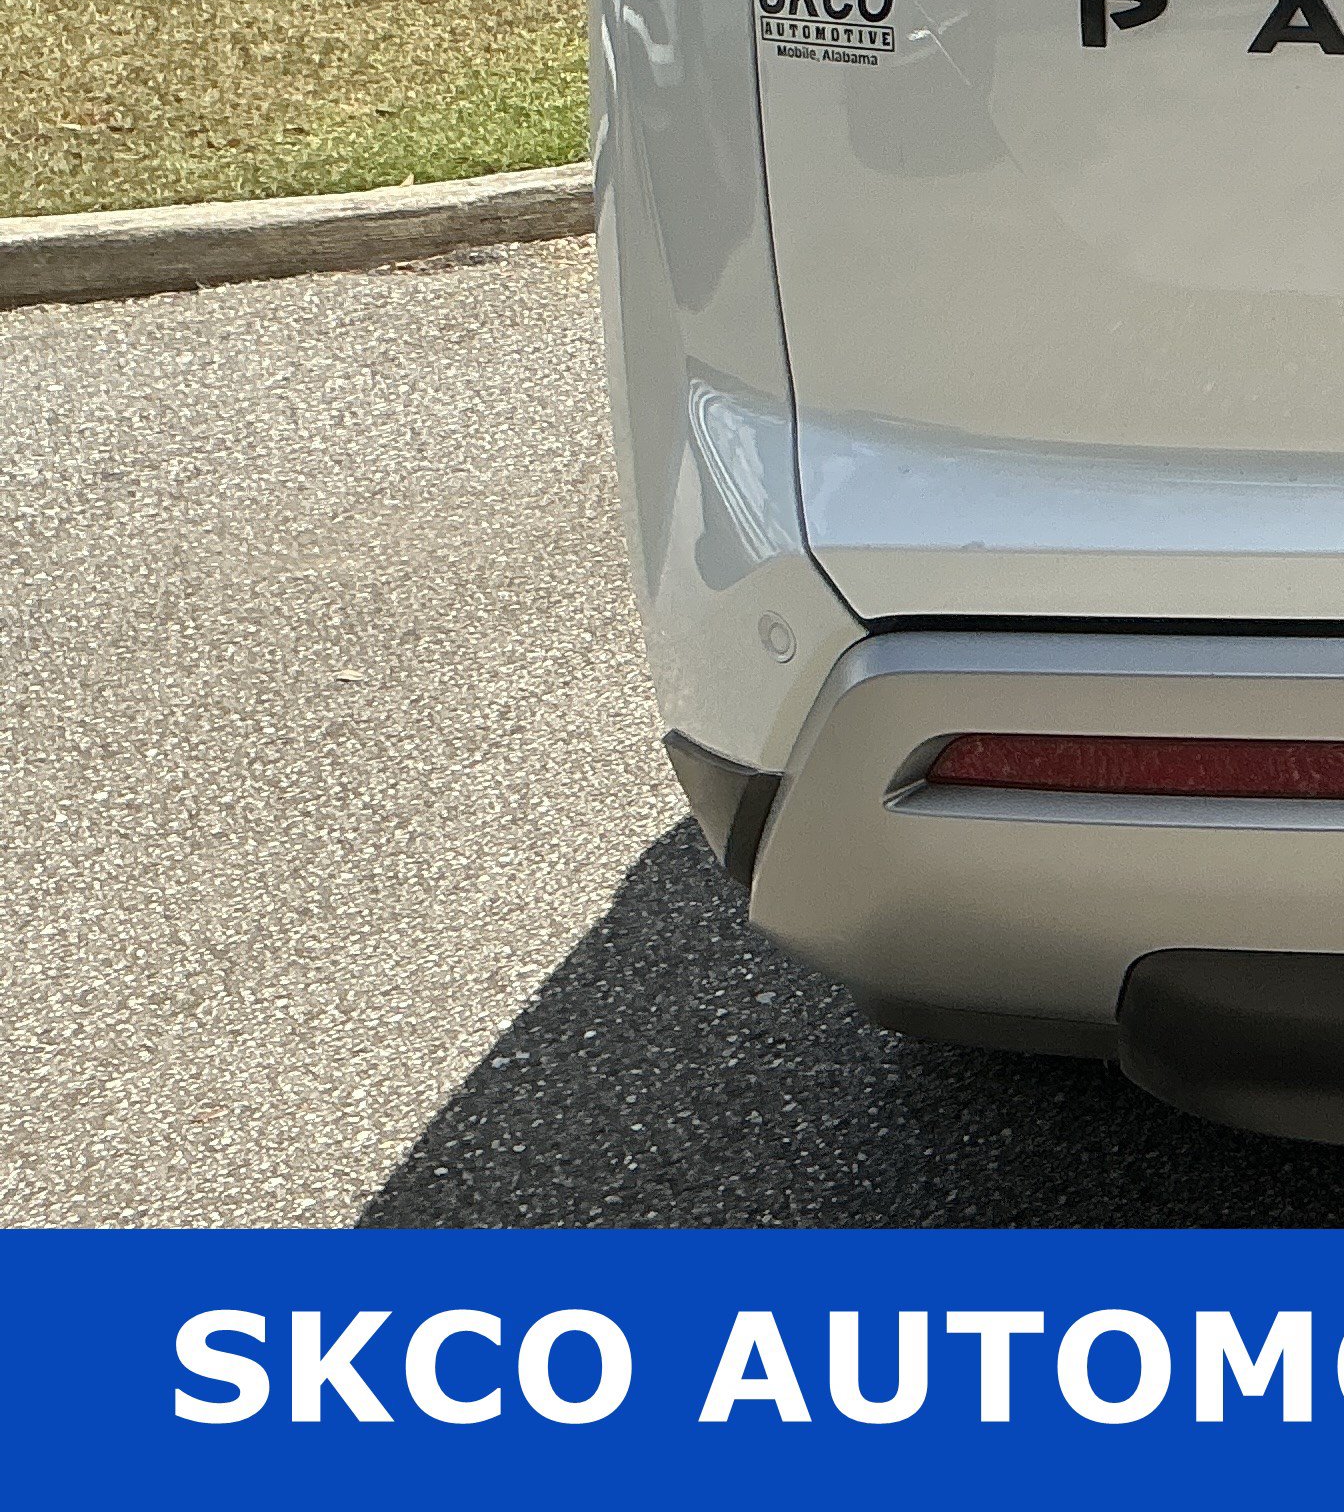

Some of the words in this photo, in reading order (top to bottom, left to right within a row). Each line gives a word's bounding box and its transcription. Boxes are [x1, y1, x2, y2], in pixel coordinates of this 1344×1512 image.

[764, 21, 891, 47] AUTOMOTIVE
[777, 45, 821, 62] Mobile,
[822, 49, 878, 66] Alabama
